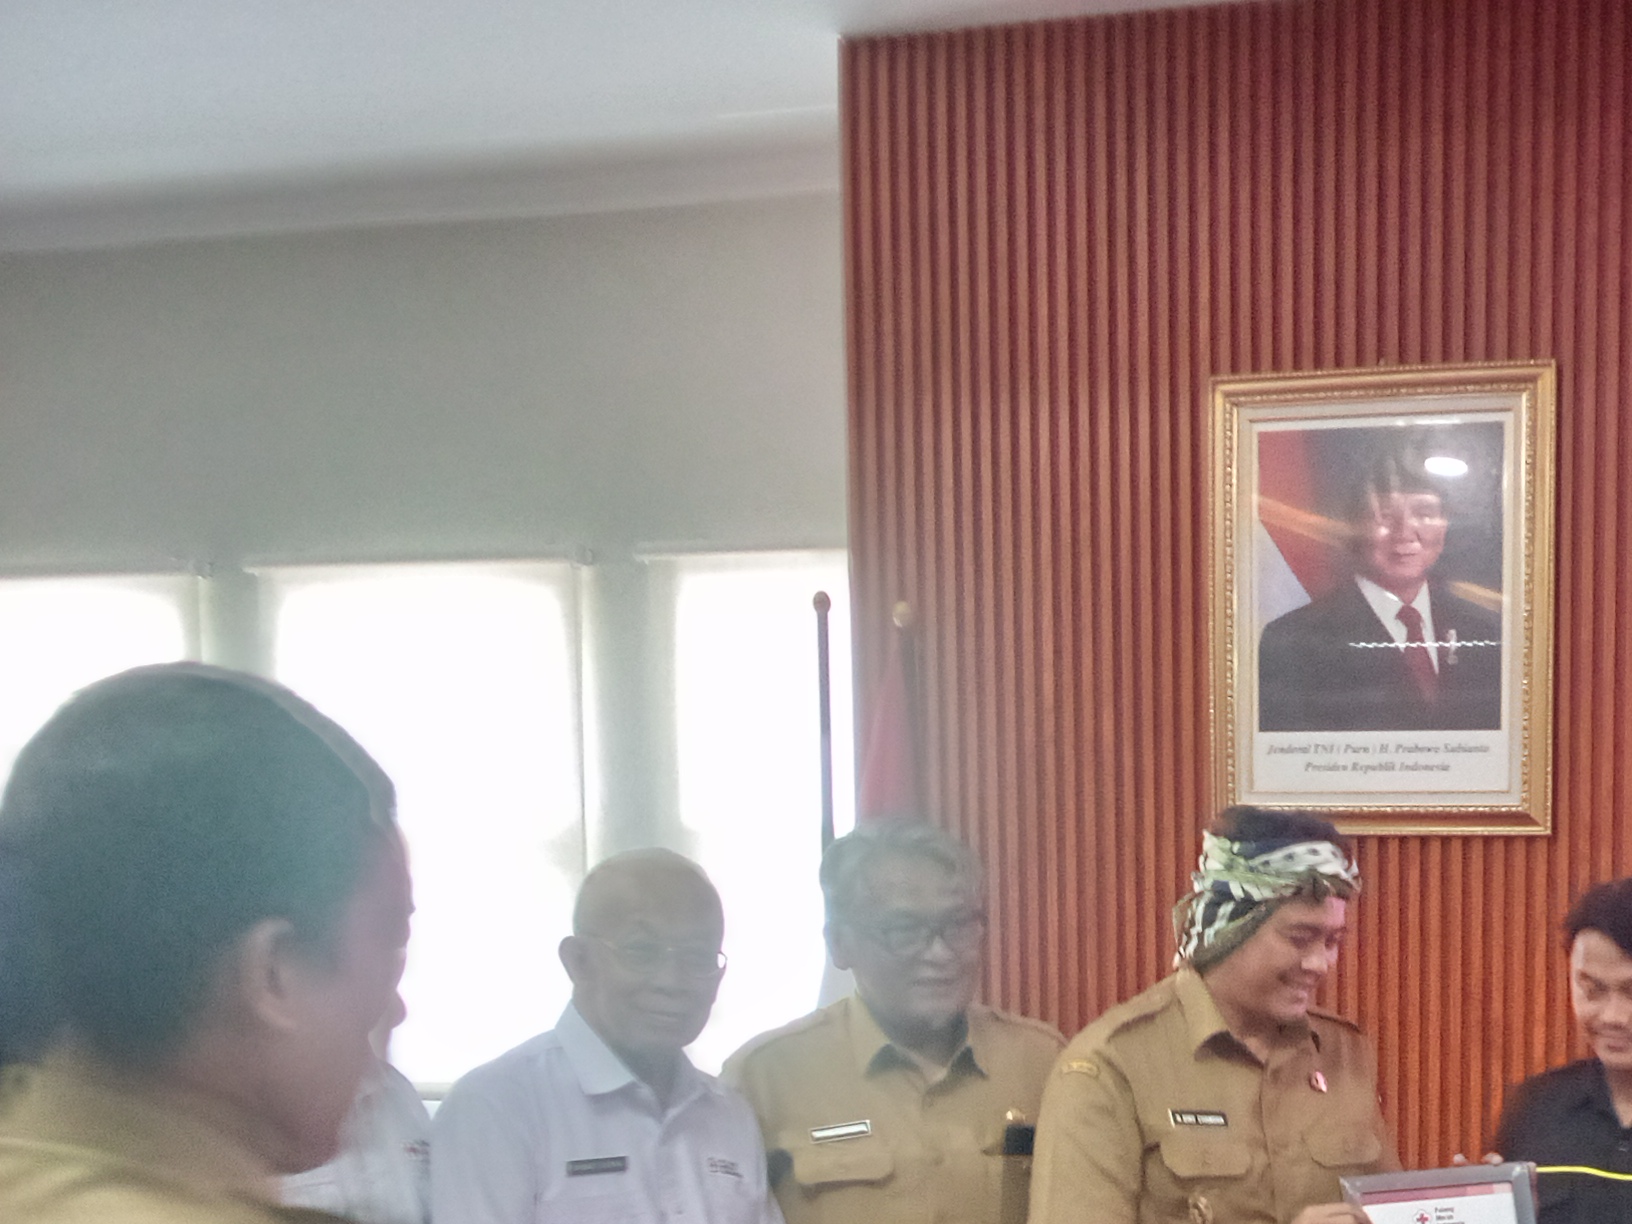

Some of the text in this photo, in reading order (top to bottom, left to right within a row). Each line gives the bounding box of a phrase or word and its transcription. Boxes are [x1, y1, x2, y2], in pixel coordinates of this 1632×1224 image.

[1304, 762, 1451, 774] Presiden Republik Indonesia
